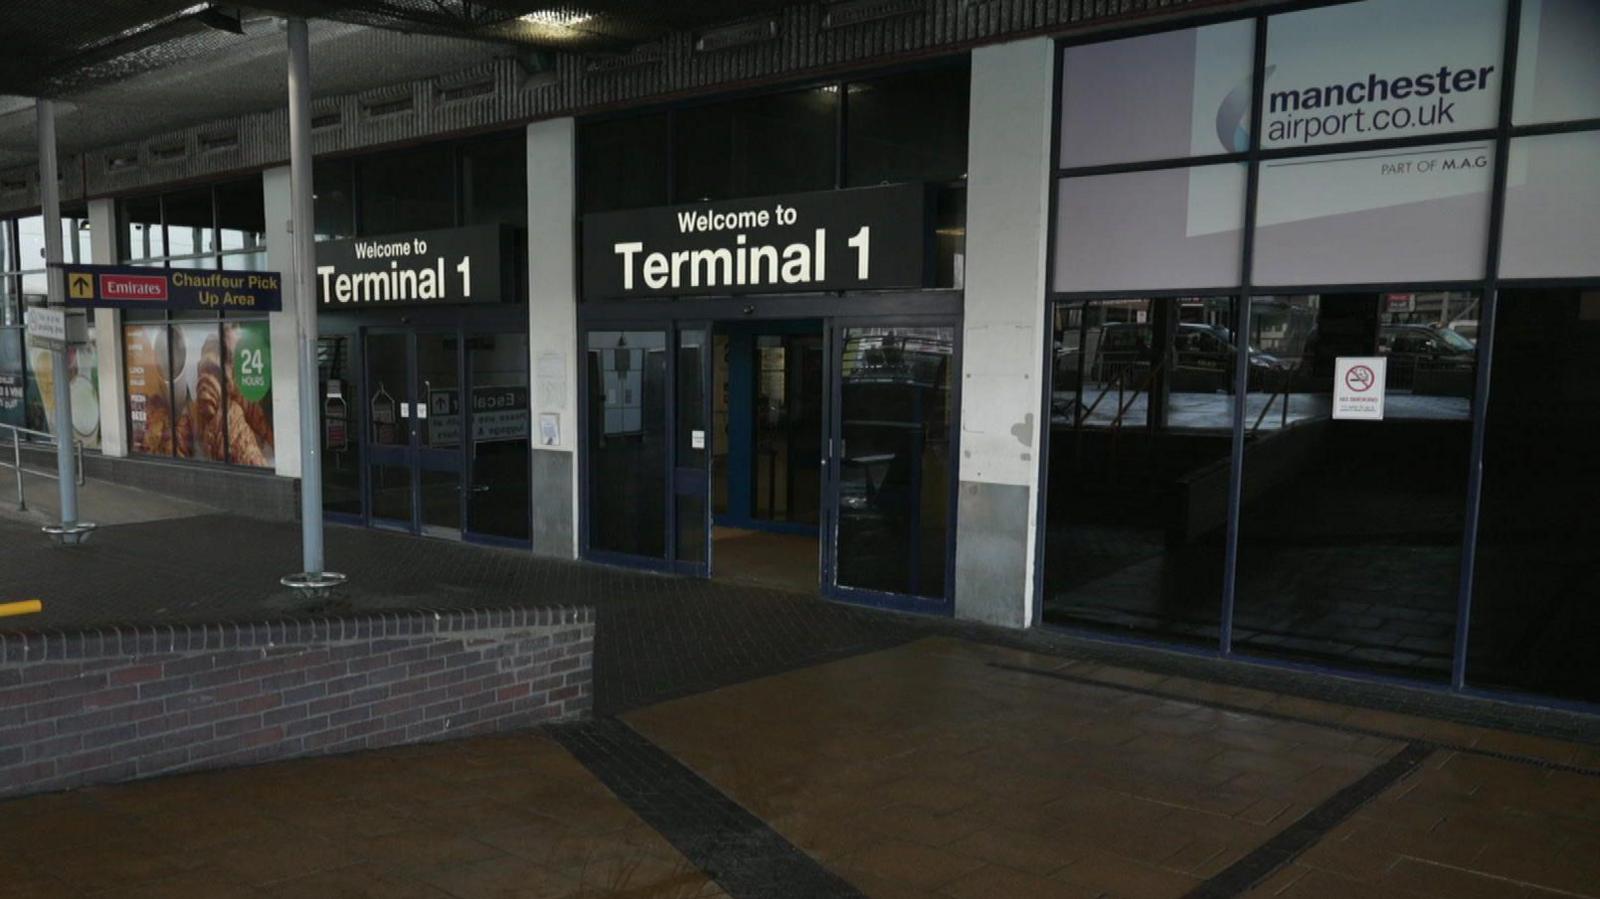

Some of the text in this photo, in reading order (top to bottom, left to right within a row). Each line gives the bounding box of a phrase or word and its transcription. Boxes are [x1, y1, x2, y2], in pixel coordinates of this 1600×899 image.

[1270, 65, 1494, 113] manchester
[1268, 97, 1456, 143] airport.co.uk
[1381, 156, 1488, 175] PART OF M.A.G
[677, 204, 798, 234] Welcome to
[354, 237, 428, 260] Welcome to
[614, 225, 871, 290] Terminal 1
[107, 281, 161, 295] Emirates
[172, 271, 279, 290] Chauffeur Pick
[316, 255, 471, 303] Terminal 1
[199, 291, 256, 306] Up Area
[241, 349, 264, 374] 24
[242, 375, 265, 387] HOURS
